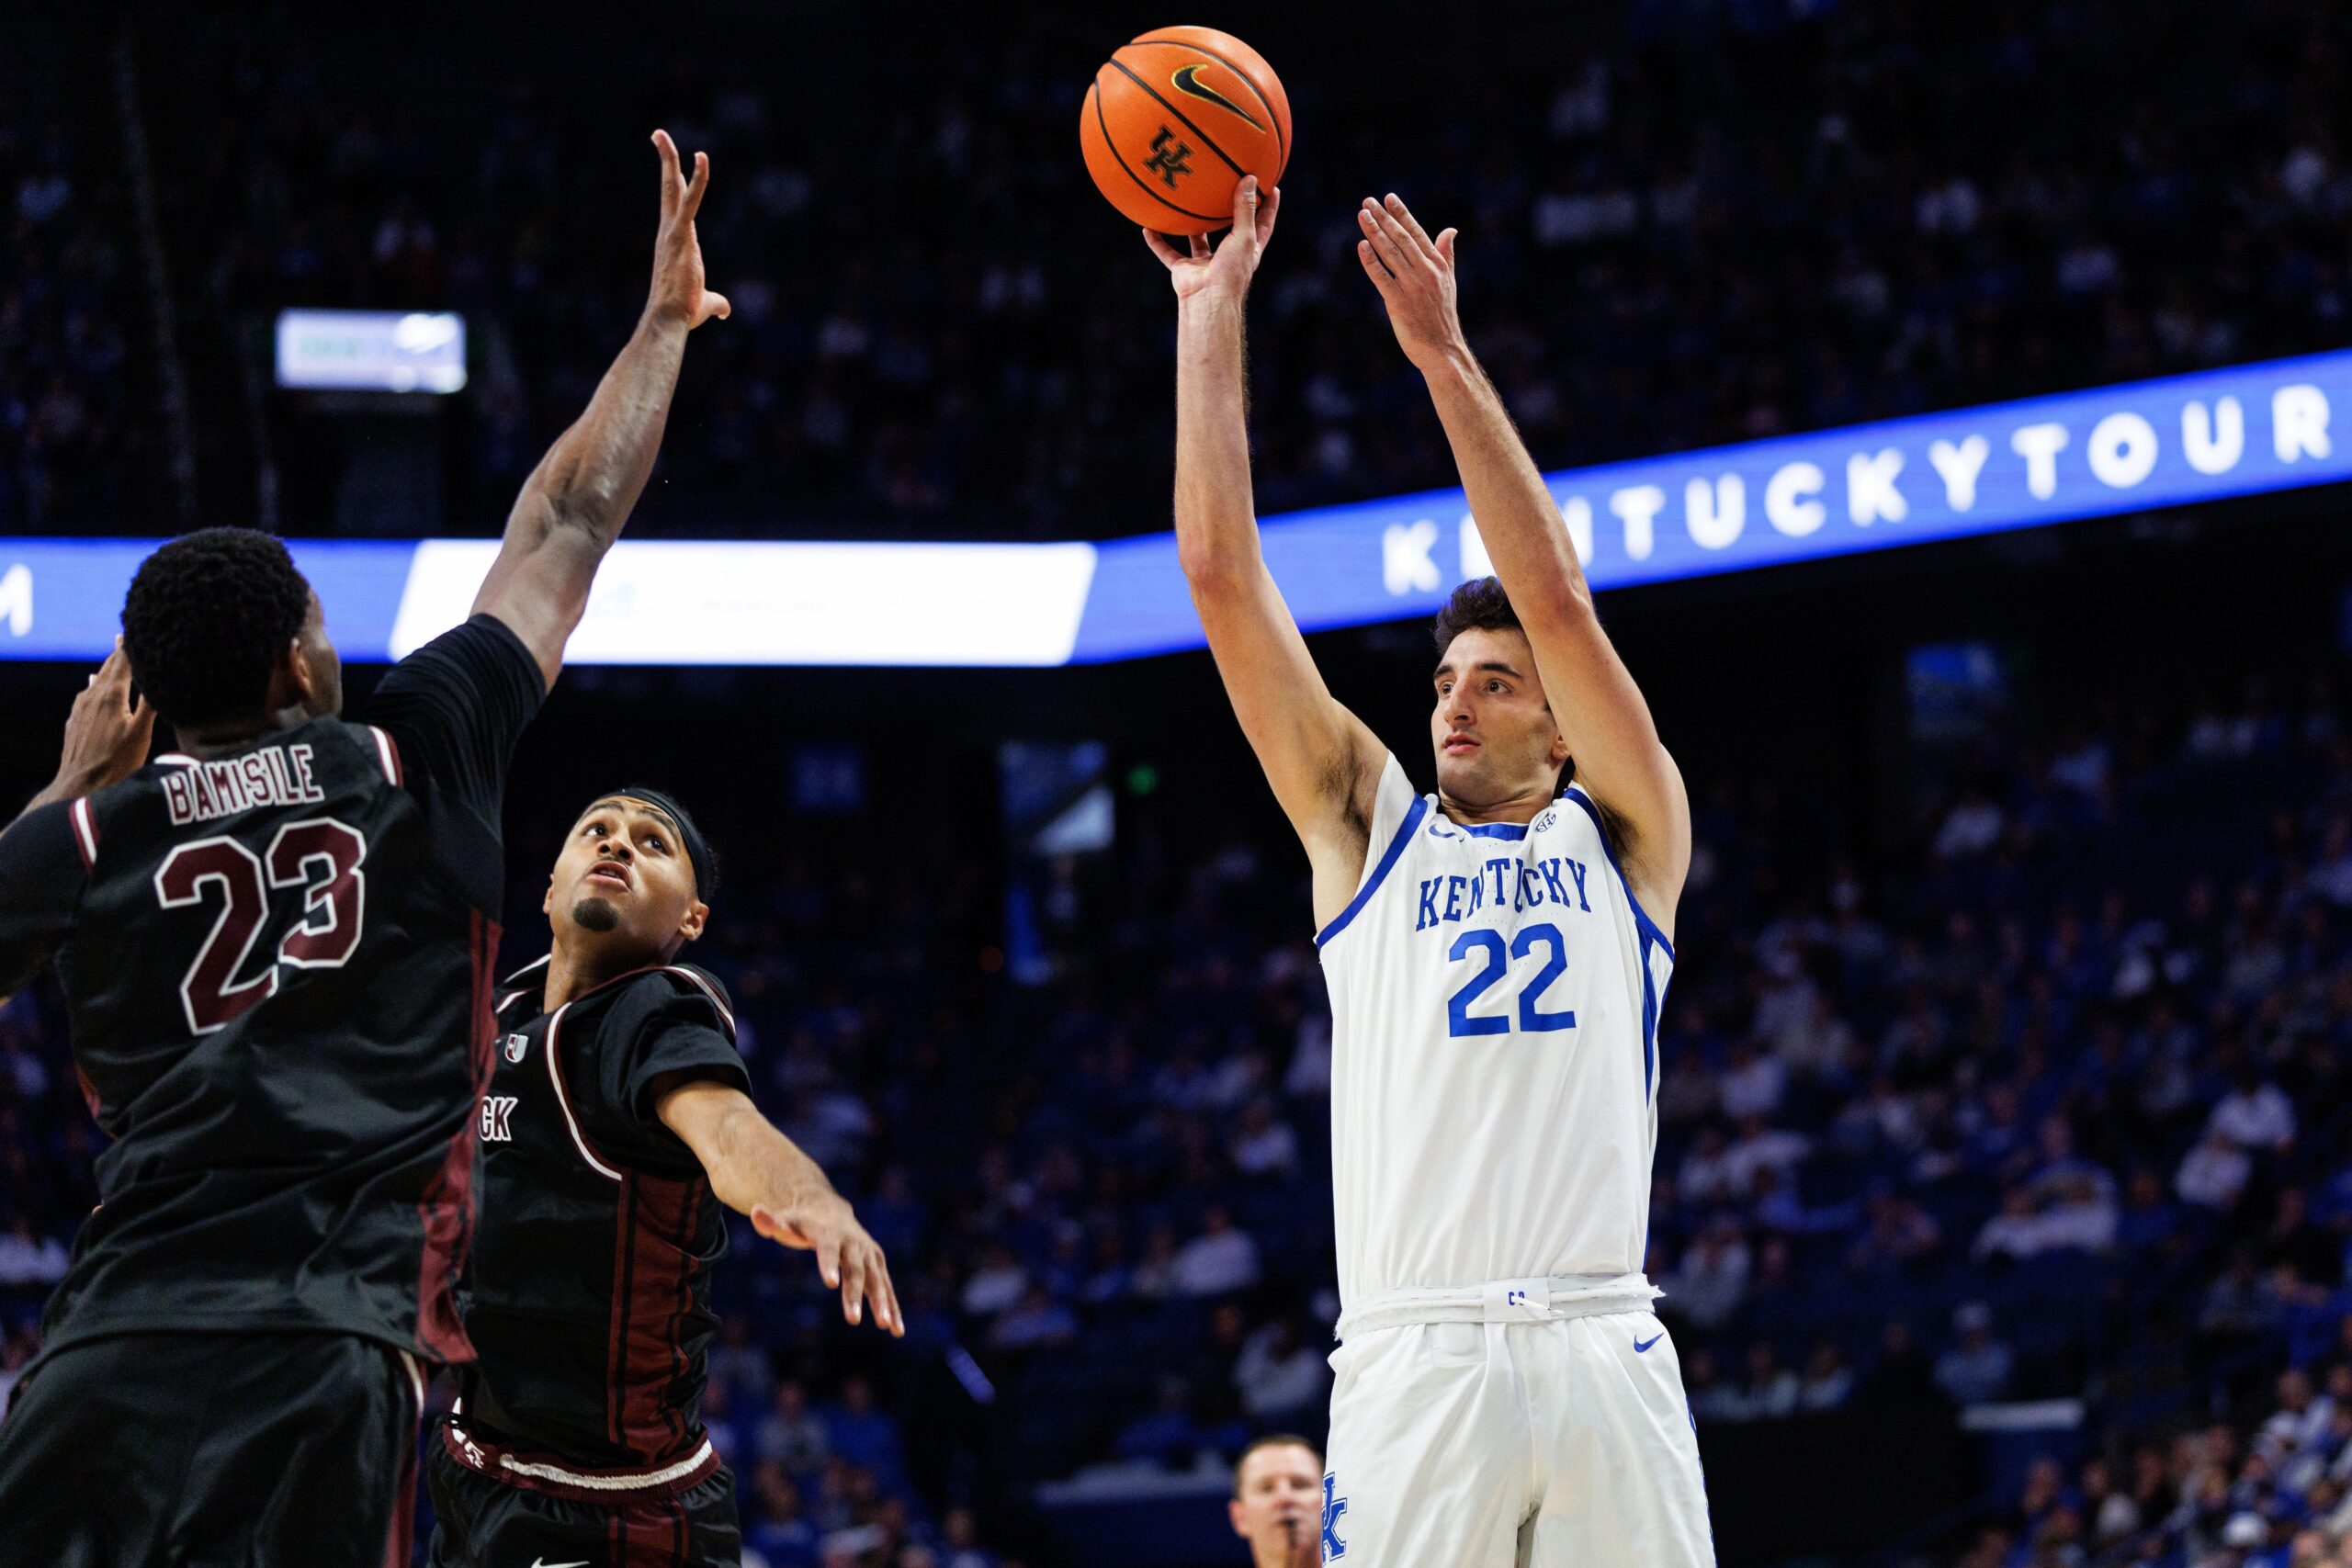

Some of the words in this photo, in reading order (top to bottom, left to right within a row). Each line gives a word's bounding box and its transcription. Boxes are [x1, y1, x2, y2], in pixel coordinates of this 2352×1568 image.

[161, 743, 324, 825] BAMISILE
[153, 817, 367, 1036] 23
[1447, 922, 1577, 1038] 22
